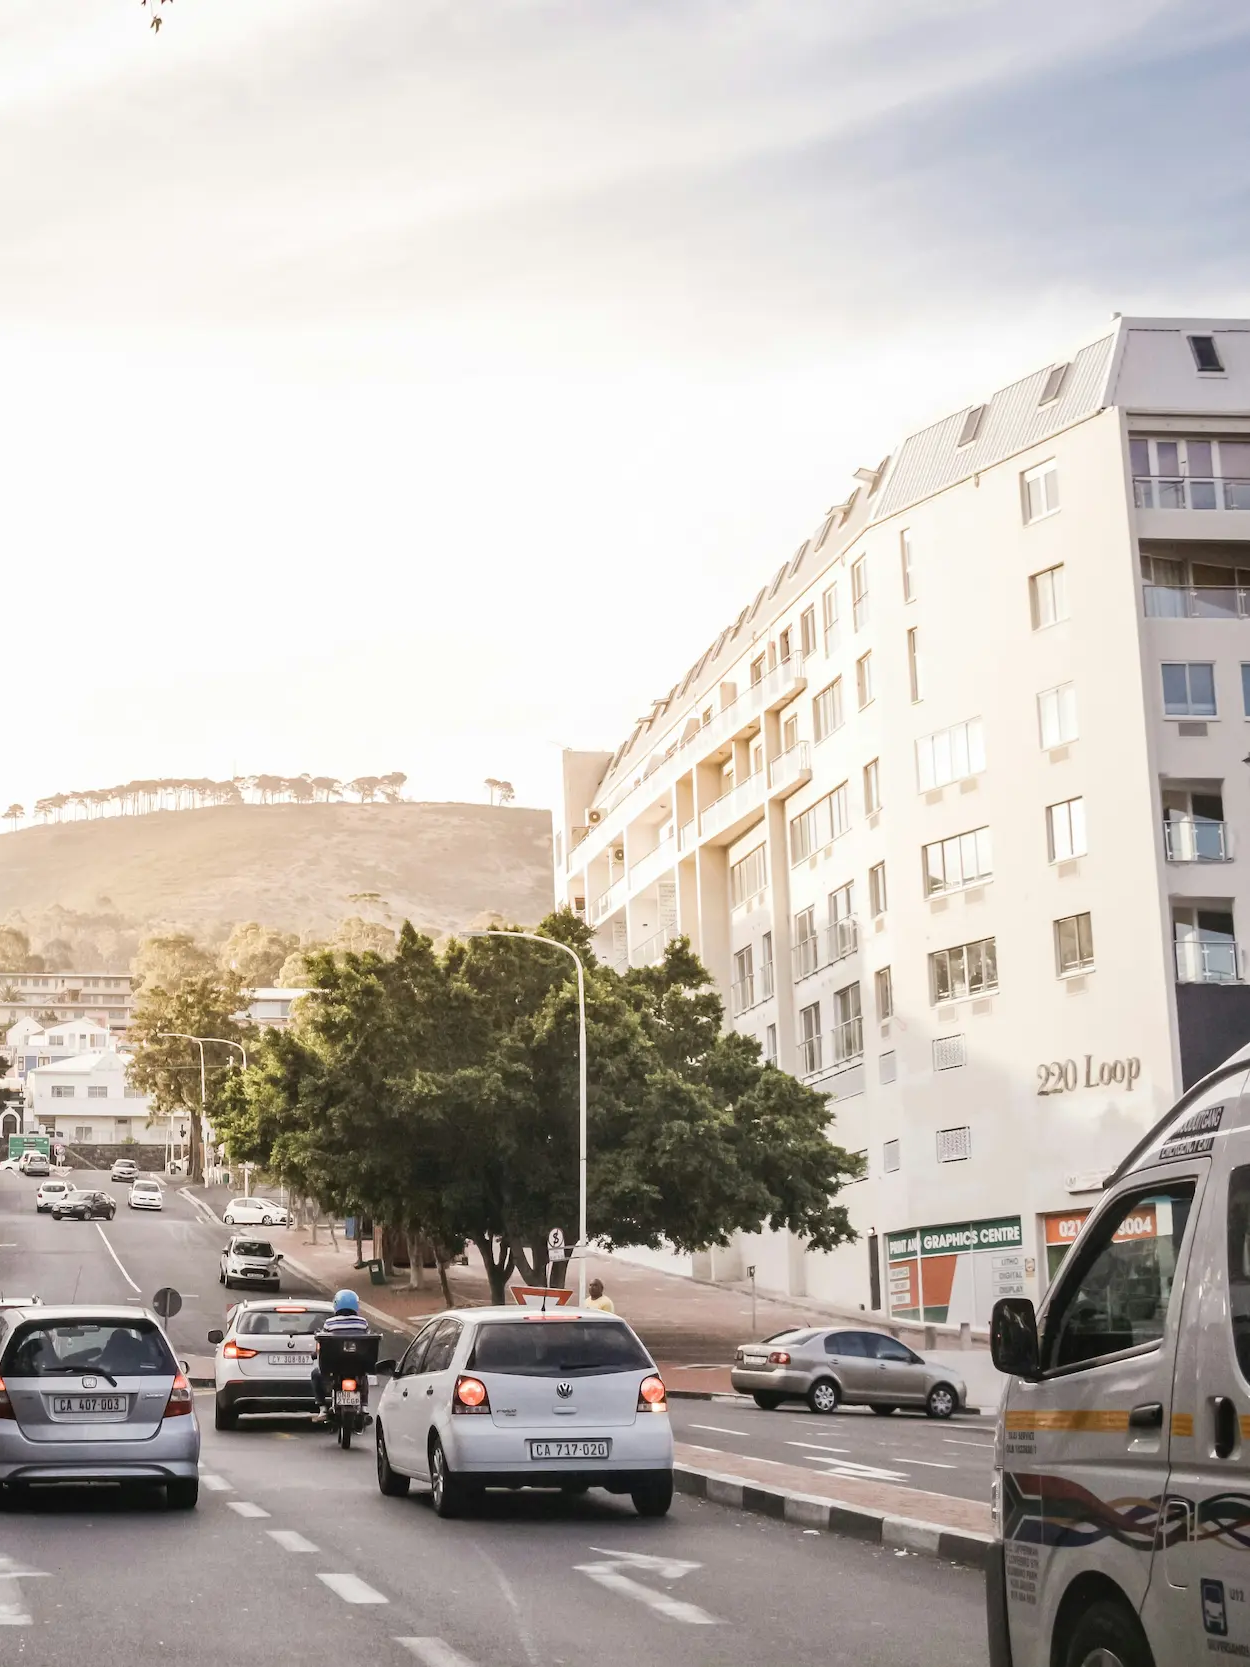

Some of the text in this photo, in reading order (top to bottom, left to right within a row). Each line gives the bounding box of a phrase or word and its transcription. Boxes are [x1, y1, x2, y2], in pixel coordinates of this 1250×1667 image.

[1037, 1054, 1141, 1096] 220 Loop
[923, 1230, 978, 1250] GRAPHICS
[979, 1226, 1020, 1244] CENTRE
[60, 1399, 72, 1411] CA
[536, 1444, 551, 1456] CA
